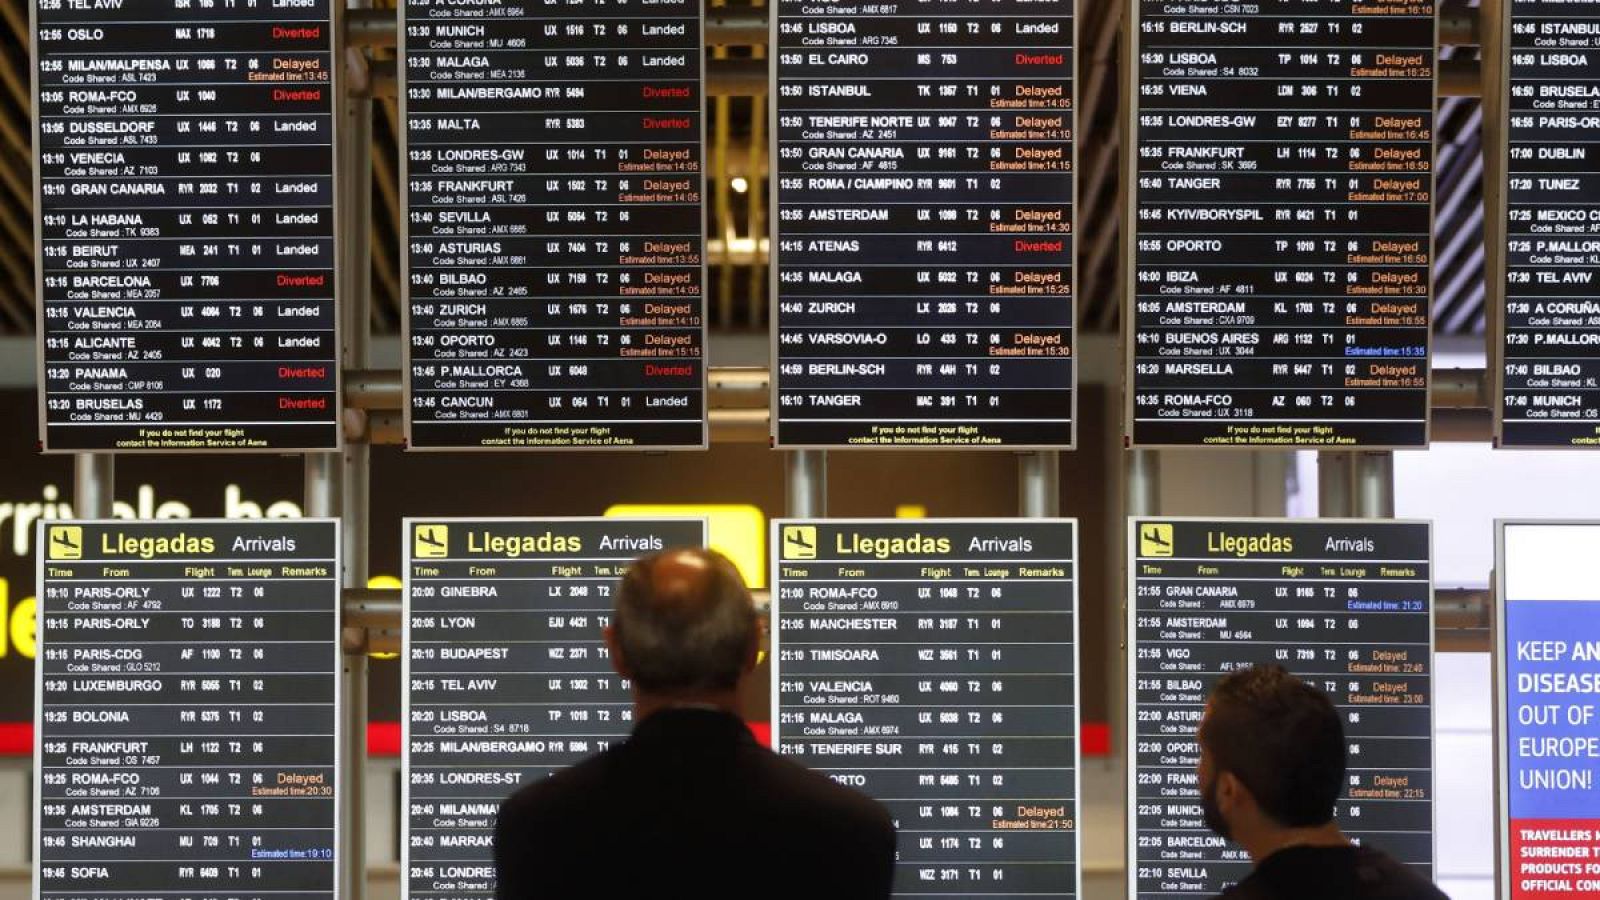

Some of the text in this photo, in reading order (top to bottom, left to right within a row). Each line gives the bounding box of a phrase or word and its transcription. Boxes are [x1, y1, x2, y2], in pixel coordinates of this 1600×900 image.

[436, 26, 484, 36] MUNICH
[809, 23, 1058, 33] LISBOA Landed
[1170, 22, 1246, 32] BERLIN-SCH
[68, 28, 320, 40] OSLO Diverted
[437, 57, 489, 67] MALAGA
[809, 54, 868, 64] EL CAIRO
[1170, 53, 1422, 66] LISBOA Delayed
[1541, 55, 1587, 65] LISBOA
[68, 60, 170, 71] MILAN/MALPENSA
[437, 88, 541, 98] MILAN/BERGAMO
[809, 85, 871, 96] ISTANBUL
[1169, 85, 1207, 95] VIENA
[69, 91, 136, 102] ROMA-FCO
[438, 119, 480, 129] MALTA
[809, 116, 912, 127] TENERIFE NORTE
[1169, 116, 1256, 127] LONDRES-GW
[70, 121, 316, 133] DUSSELDORF Landed
[438, 150, 524, 160] LONDRES-GW
[809, 148, 904, 158] GRAN CANARIA
[1169, 147, 1244, 157] FRANKFURT
[1539, 148, 1584, 159] DUBLIN
[70, 153, 124, 164] VENECIA
[439, 181, 513, 191] FRANKFURT
[809, 179, 913, 189] ROMA CIAMPINO
[1168, 178, 1220, 188] TANGER
[1538, 179, 1579, 189] TUNEZ
[72, 184, 165, 195] GRAN CANARIA
[439, 212, 491, 223] SEVILLA
[809, 209, 888, 220] AMSTERDAM
[1168, 209, 1263, 220] KYIV/BORYSPIL
[72, 215, 143, 225] LA HABANA
[73, 245, 118, 256] BEIRUT
[439, 243, 501, 253] ASTURIAS
[809, 241, 1062, 251] ATENAS Diverted
[1167, 240, 1221, 251] OPORTO
[440, 274, 486, 284] BILBAO
[809, 272, 862, 282] MALAGA
[1167, 272, 1198, 281] IBIZA
[1536, 272, 1592, 283] TEL AVIV
[73, 276, 151, 288] BARCELONA
[74, 307, 136, 317] VALENCIA
[440, 304, 485, 315] ZURICH
[808, 303, 855, 313] ZURICH
[1166, 302, 1244, 312] AMSTERDAM
[75, 337, 135, 348] ALICANTE
[441, 335, 494, 345] OPORTO
[809, 333, 887, 344] VARSOVIA-O
[1166, 333, 1259, 344] BUENOS AIRES
[76, 368, 127, 378] PANAMA
[441, 366, 522, 376] P.MALLORCA
[809, 364, 884, 375] BERLIN-SCH
[1166, 364, 1416, 376] MARSELLA Delayed
[1534, 365, 1580, 375] BILBAO
[76, 399, 143, 409] BRUSELAS
[441, 396, 687, 407] CANCUN Landed
[809, 395, 976, 405] TANGER T1
[1165, 395, 1232, 405] ROMA-FCO
[1533, 396, 1581, 406] MUNICH
[1158, 409, 1212, 418] Code Shared
[103, 533, 295, 560] Llegadas Arrivals
[469, 532, 663, 557] Llegadas Arrivals
[837, 534, 1032, 558] Llegadas Arrivals
[1209, 532, 1374, 558] Llegadas Arrivals
[49, 567, 328, 579] Time From Flight Remarks
[552, 566, 581, 578] Flight
[75, 588, 150, 598] PARIS-ORLY
[441, 587, 497, 596] GINEBRA
[810, 588, 877, 598] ROMA-FCO
[75, 618, 149, 628] PARIS-ORLY
[441, 617, 475, 628] LYON
[811, 619, 896, 629] MANCHESTER
[1167, 618, 1226, 627] AMSTERDAM
[74, 649, 142, 659] PARIS-CDG
[441, 648, 508, 659] BUDAPEST
[810, 650, 879, 660] TIMISOARA
[1167, 649, 1190, 658] VIGO
[1518, 641, 1566, 660] KEEP
[73, 680, 162, 691] LUXEMBURGO
[441, 680, 496, 690] TEL AVIV
[810, 681, 872, 692] VALENCIA
[1167, 680, 1202, 690] BILBAO
[73, 712, 129, 722] BOLONIA
[441, 711, 487, 721] LISBOA
[811, 712, 863, 723] MALAGA
[1519, 705, 1594, 725] OUT OF
[73, 742, 148, 753] FRANKFURT
[440, 742, 545, 752] MILAN/BERGAMO
[811, 744, 902, 754] TENERIFE SUR
[72, 773, 323, 786] ROMA-FCO Delayed
[440, 773, 521, 784] LONDRES-ST
[1520, 769, 1591, 789] UNION!
[72, 805, 151, 815] AMSTERDAM
[1018, 807, 1064, 819] Delayed
[1520, 830, 1592, 840] TRAVELLERS
[72, 836, 135, 847] SHANGHAI
[1168, 837, 1225, 847] BARCELONA
[1521, 847, 1589, 857] SURRENDER
[71, 868, 108, 878] SOFIA
[1168, 868, 1207, 878] SEVILLA
[1521, 863, 1582, 874] PRODUCTS
[1521, 880, 1572, 891] OFFICIAL
